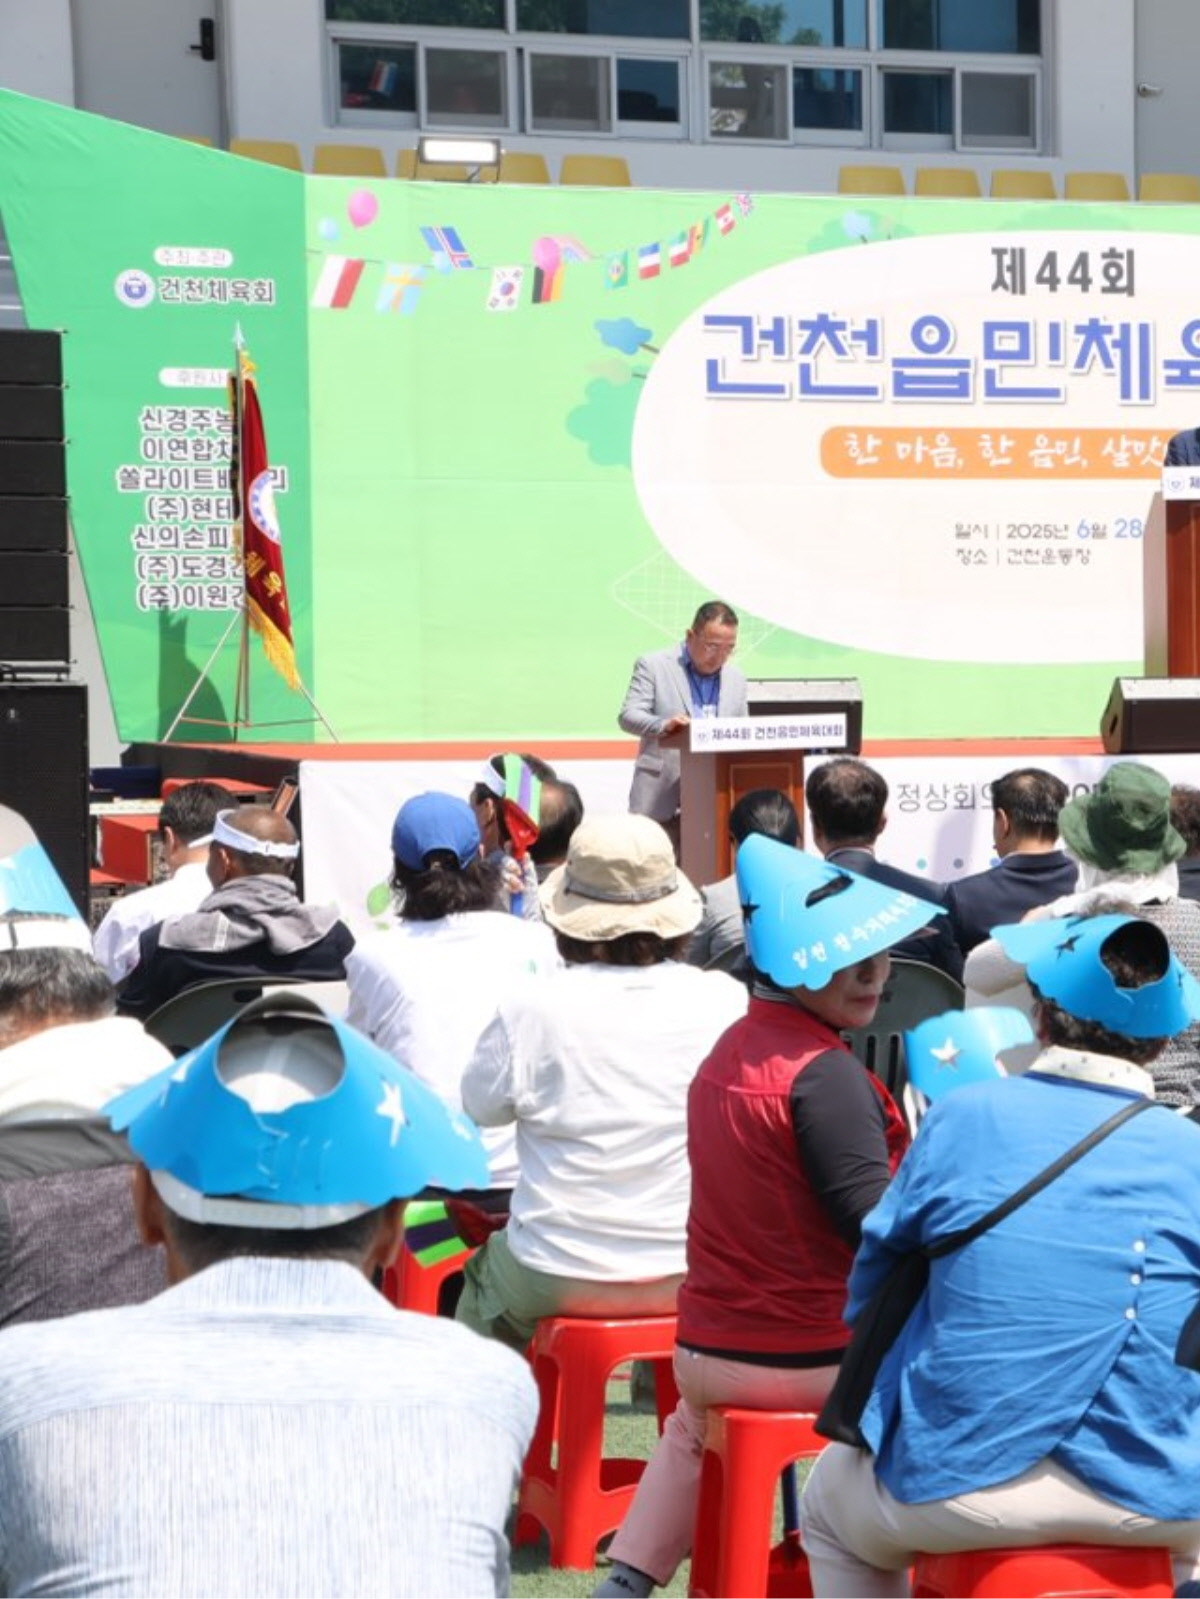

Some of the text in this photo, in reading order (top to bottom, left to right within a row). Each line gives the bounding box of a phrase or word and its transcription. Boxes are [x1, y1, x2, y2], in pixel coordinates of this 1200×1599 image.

[990, 247, 1136, 296] 제44회
[160, 277, 273, 303] 건천체육회
[142, 409, 234, 432] 신경주농
[143, 437, 234, 462] 이연합
[844, 433, 883, 466] 한
[896, 432, 964, 468] 마음,
[977, 433, 1015, 467] 한
[1102, 434, 1168, 467] 살맛
[118, 466, 286, 491] 쏠라이트배리
[148, 496, 236, 521] (주)현대
[134, 526, 229, 549] 신의손피
[955, 523, 988, 540] 일시
[1006, 523, 1070, 540] 2025년
[1077, 519, 1107, 540] 6월
[138, 555, 242, 580] (주)도경
[956, 548, 1091, 566] 장소 건천운동장
[139, 584, 244, 609] (주)이원
